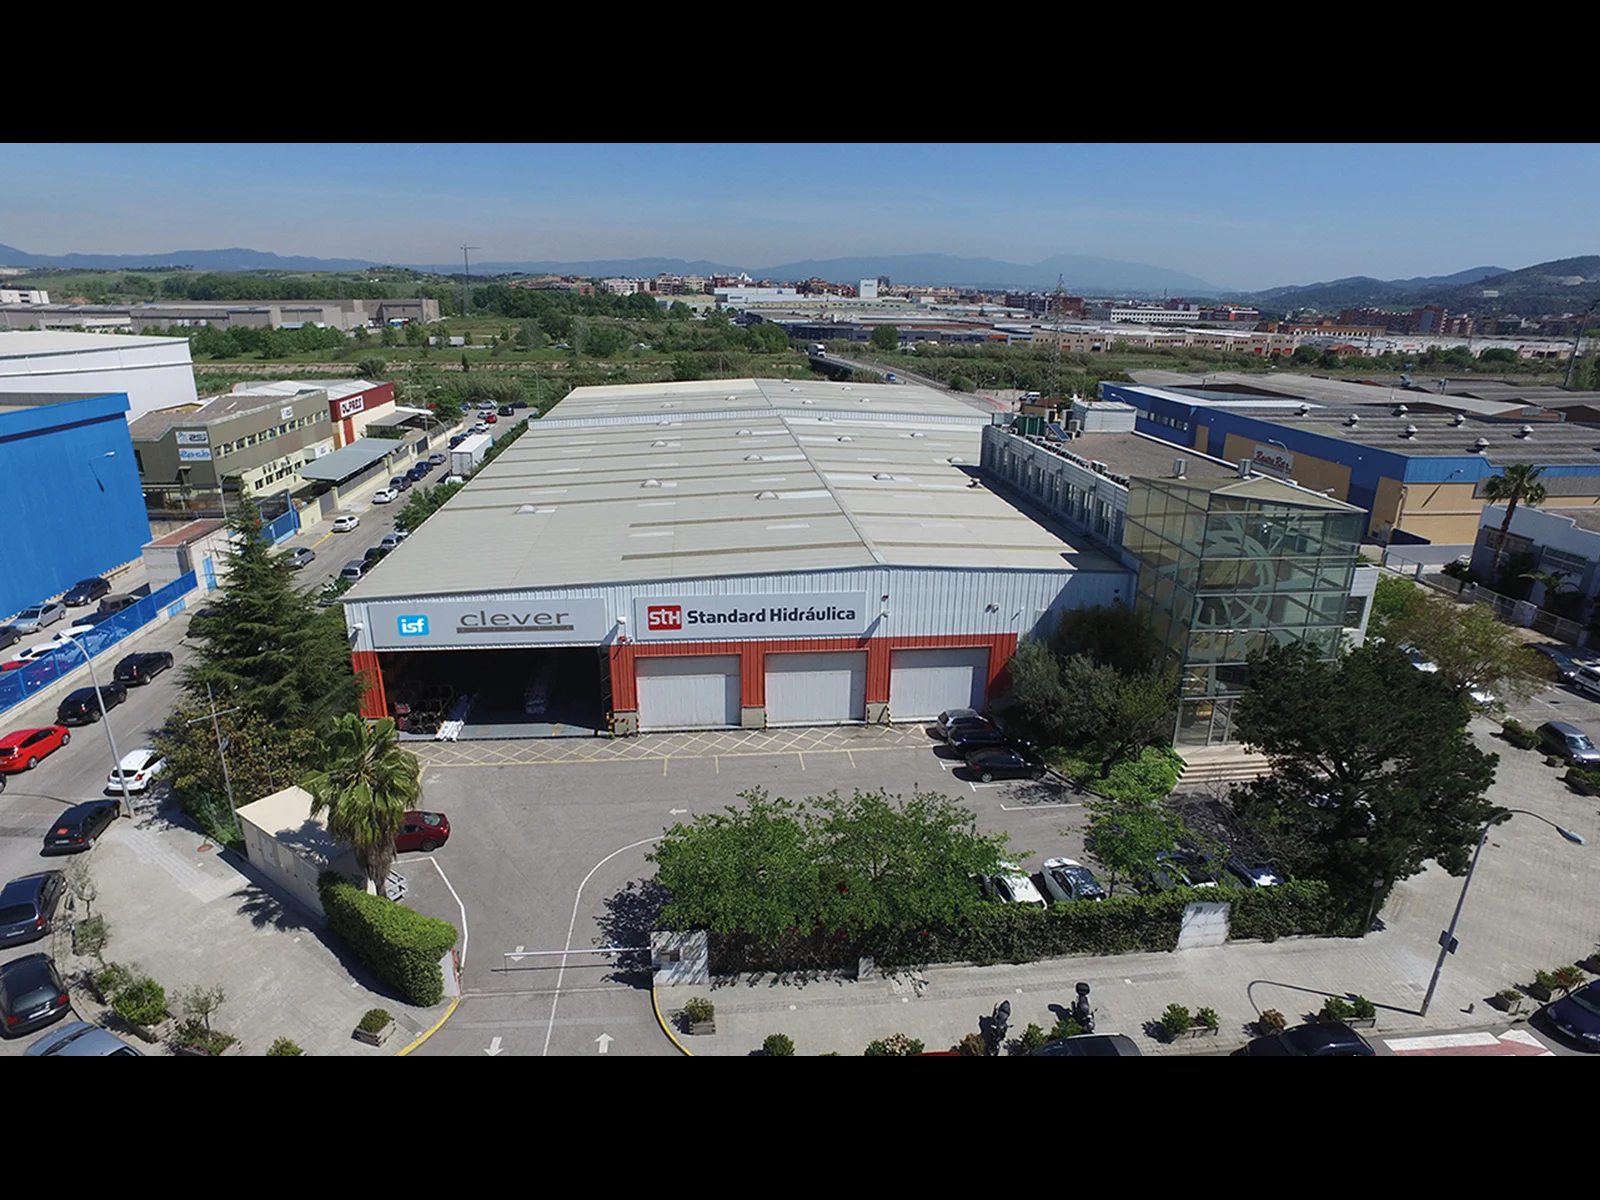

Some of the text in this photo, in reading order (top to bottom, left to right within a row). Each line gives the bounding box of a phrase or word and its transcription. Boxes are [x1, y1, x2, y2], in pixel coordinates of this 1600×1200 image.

[460, 610, 570, 626] clever
[687, 608, 766, 624] Standard
[770, 606, 856, 621] Hidráulica
[401, 618, 425, 633] isf
